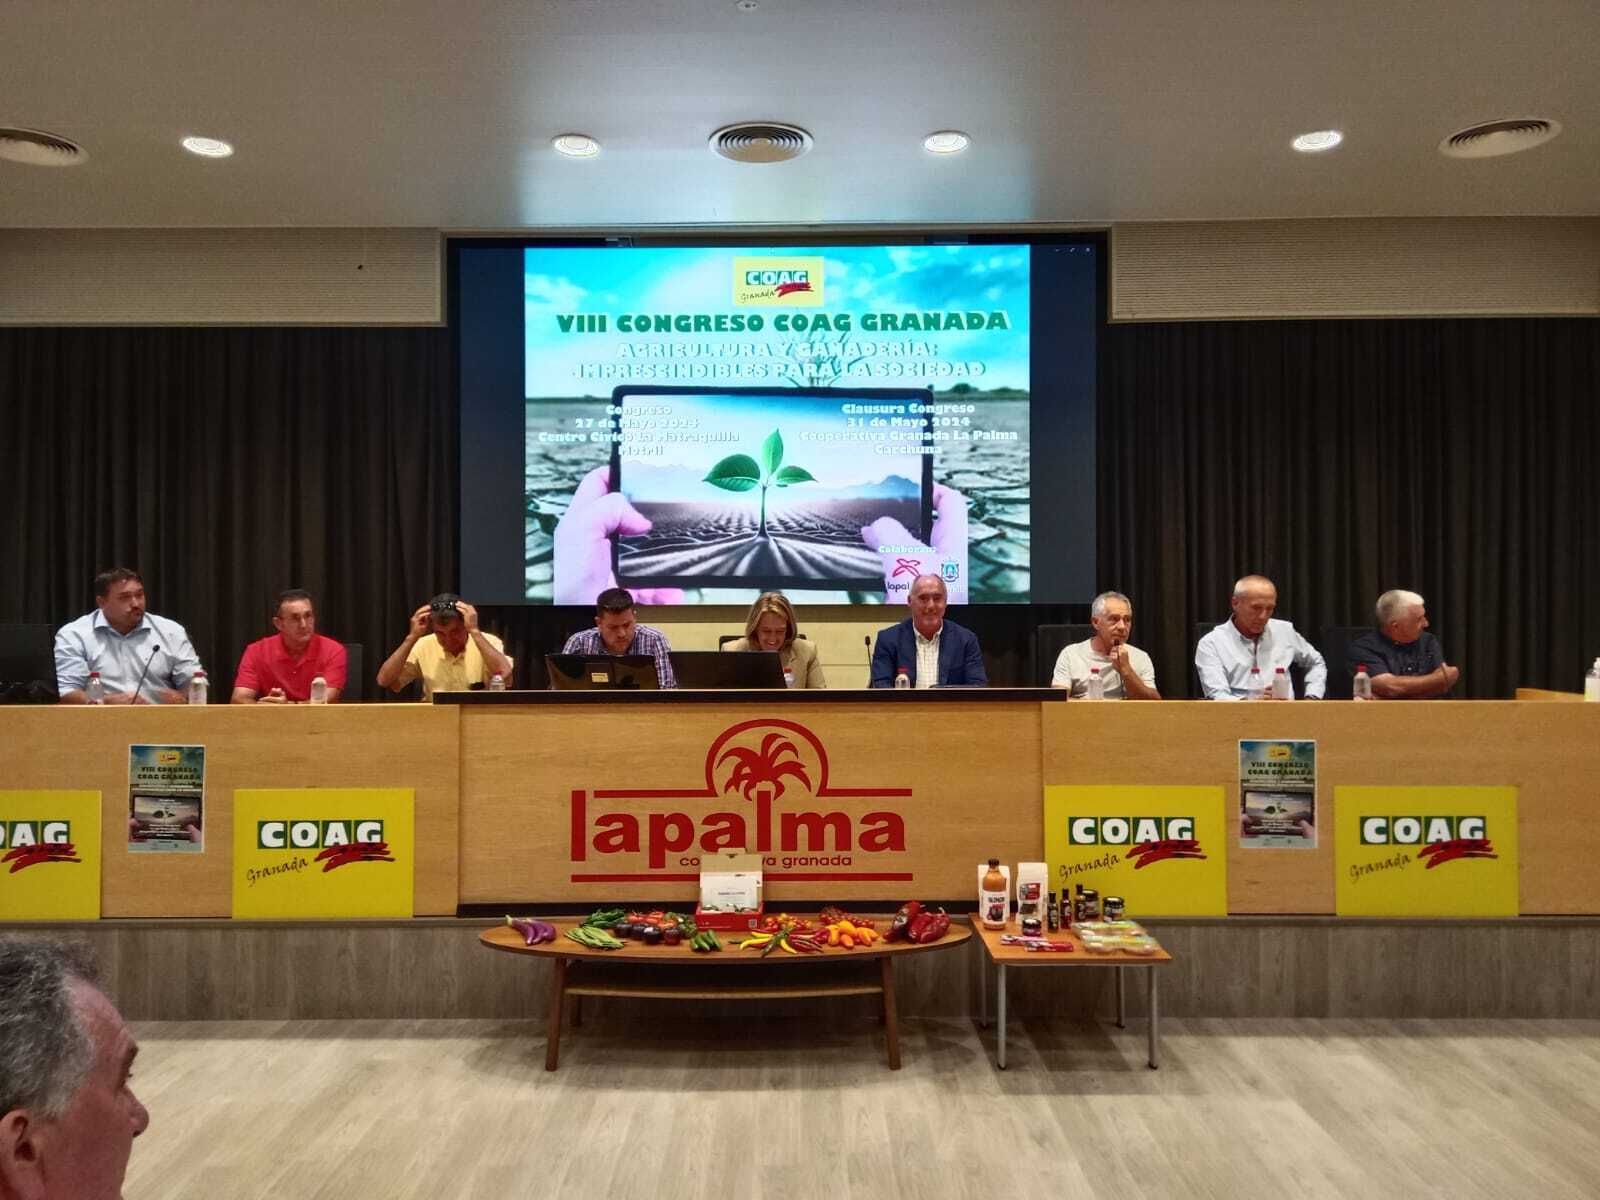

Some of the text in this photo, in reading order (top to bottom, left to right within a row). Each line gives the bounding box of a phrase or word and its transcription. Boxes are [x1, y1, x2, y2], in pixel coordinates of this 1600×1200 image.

[746, 270, 808, 285] COAG
[556, 311, 1010, 333] VIII CONGRESO COAG GRANADA
[615, 342, 774, 358] AGRICULTURA
[573, 362, 769, 379] IMPRESCINDIBLES
[772, 361, 841, 377] PARA
[875, 361, 987, 377] SOCIEDAD
[605, 404, 673, 417] Congreso
[841, 403, 976, 416] Clausura Congreso
[575, 417, 593, 429] 27
[598, 417, 616, 429] de
[618, 417, 657, 432] Mayo
[847, 416, 971, 430] 31 de Mayo 2024
[538, 431, 587, 443] Centro
[799, 429, 1019, 443] Cooperativa Granada La Palma
[874, 443, 943, 456] Carchuna
[260, 821, 382, 848] COAG
[571, 790, 906, 869] lapalma
[1072, 818, 1192, 844] COAG
[1363, 818, 1484, 843] COAG
[782, 855, 852, 868] granada
[1059, 853, 1120, 880] Granada
[1350, 853, 1412, 884] Granada
[247, 857, 310, 887] Granada
